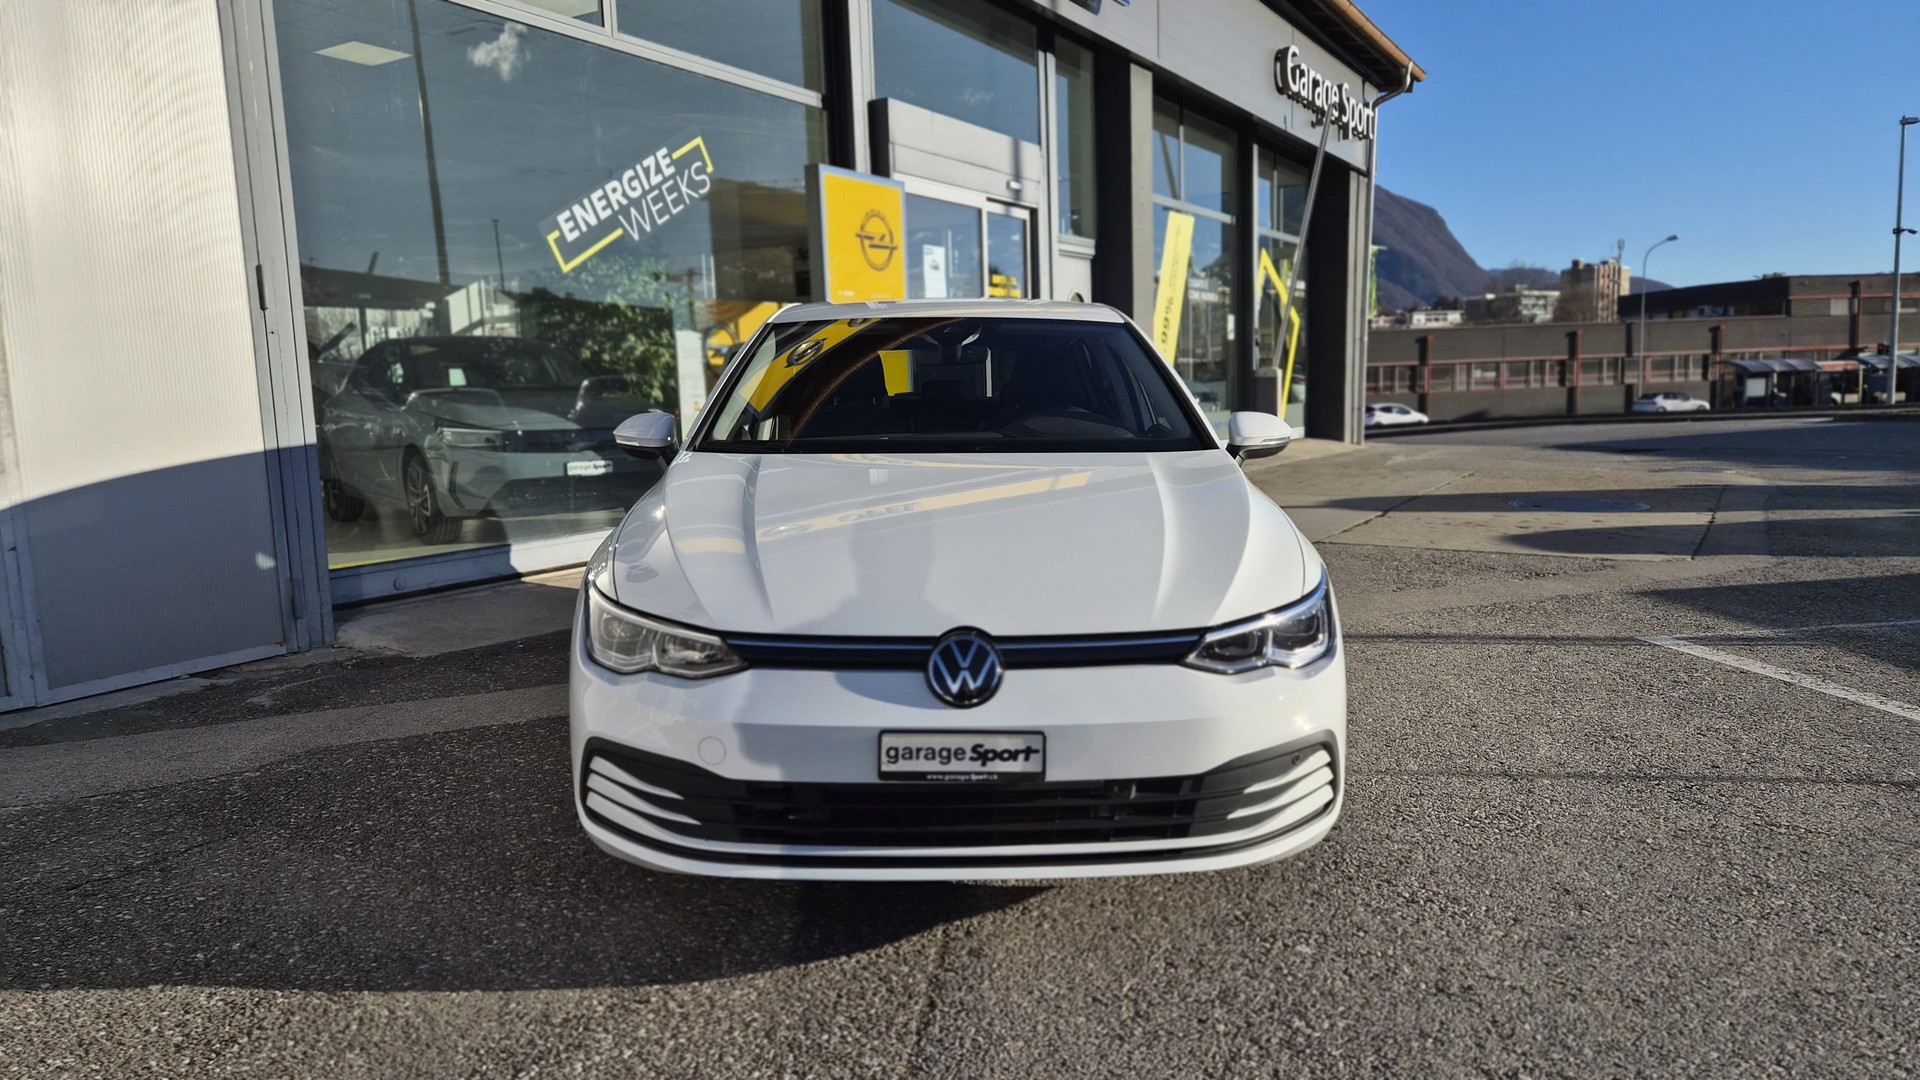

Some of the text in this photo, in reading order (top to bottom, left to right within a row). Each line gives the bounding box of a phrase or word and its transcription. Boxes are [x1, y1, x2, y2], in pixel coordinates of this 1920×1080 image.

[1286, 44, 1374, 140] Garage Sport
[556, 147, 676, 243] ENERGIZE
[618, 161, 711, 241] WEEKS
[885, 743, 1041, 767] garage Sport
